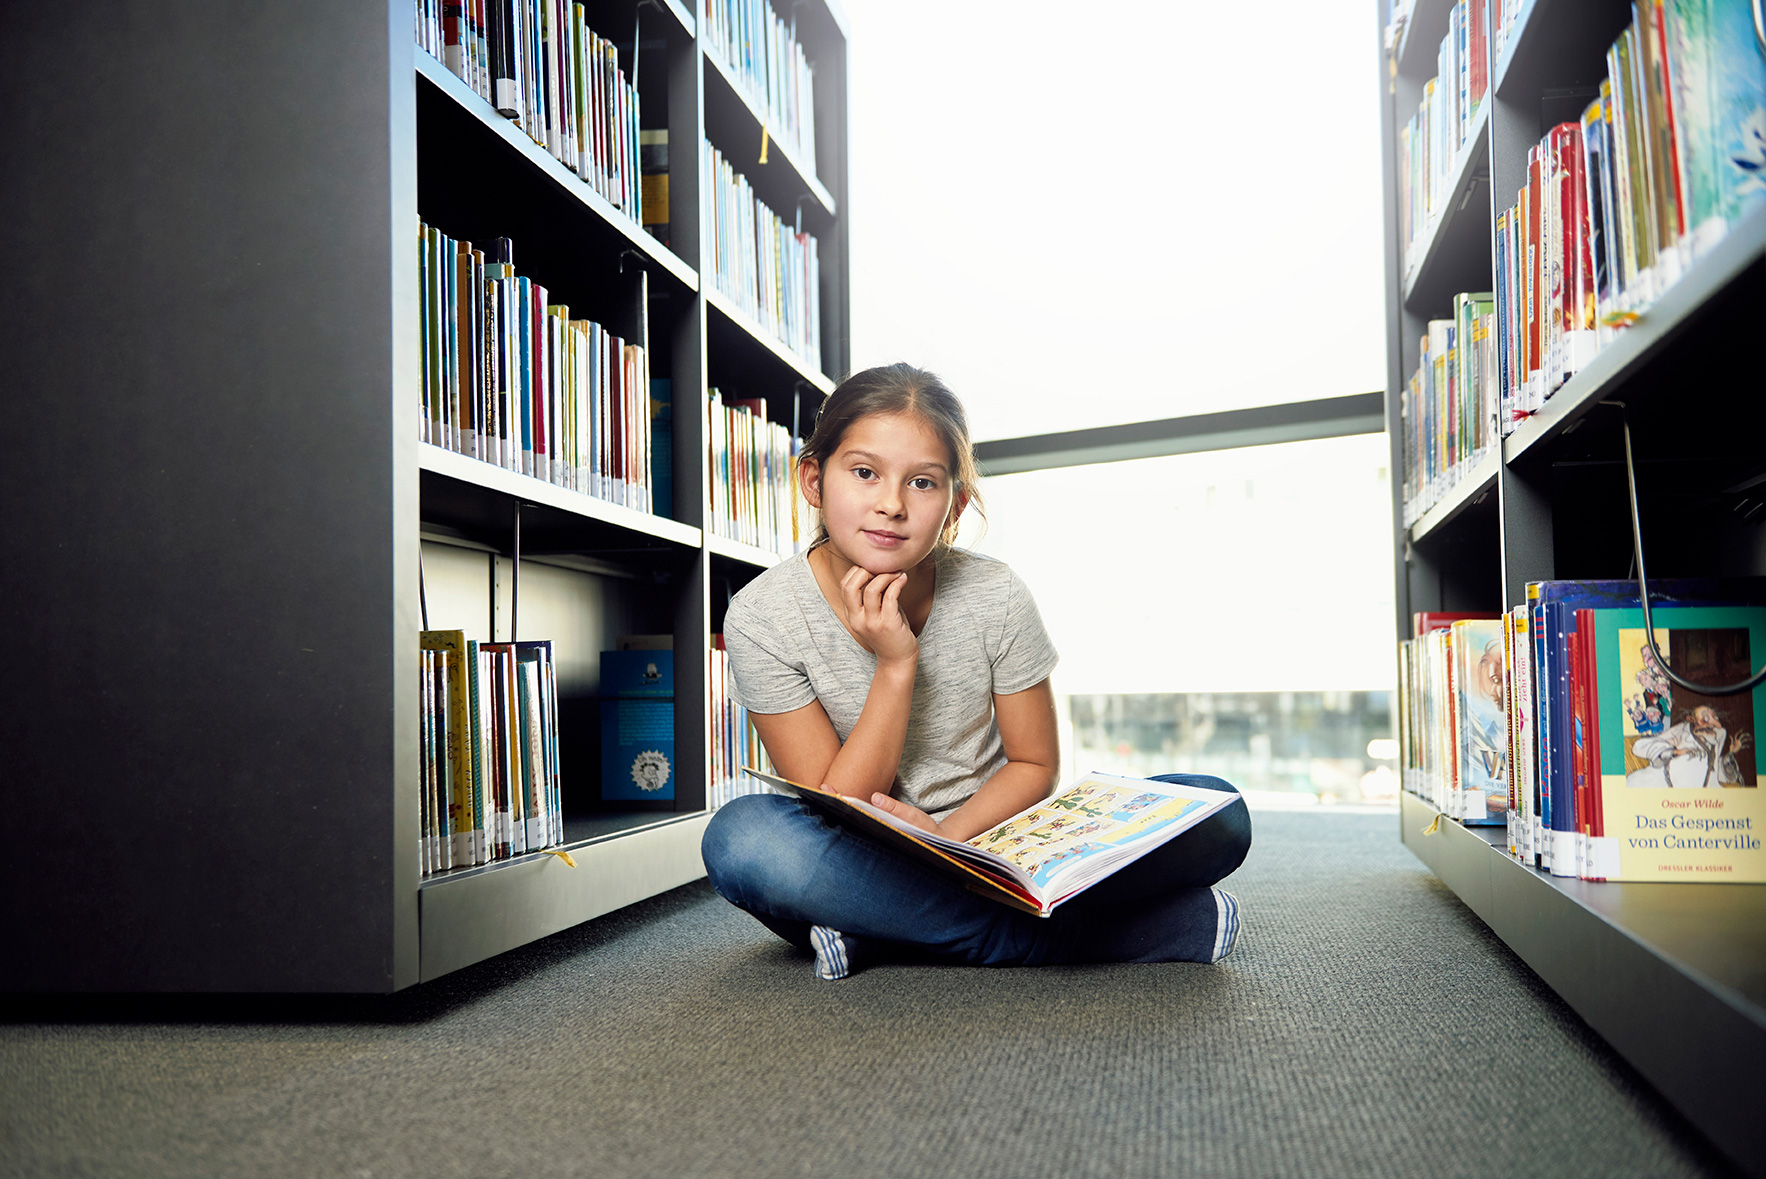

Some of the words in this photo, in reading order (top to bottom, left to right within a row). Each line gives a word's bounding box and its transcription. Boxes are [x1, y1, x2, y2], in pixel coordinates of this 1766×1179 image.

[1661, 799, 1691, 809] Oscar
[1694, 799, 1724, 809] Wilde
[1635, 815, 1667, 830] Das
[1671, 814, 1753, 832] Gespenst
[1628, 838, 1659, 849] von
[1663, 834, 1761, 849] Canterville
[1658, 864, 1694, 873] DRESSLER
[1695, 864, 1733, 873] KLASSIKER
